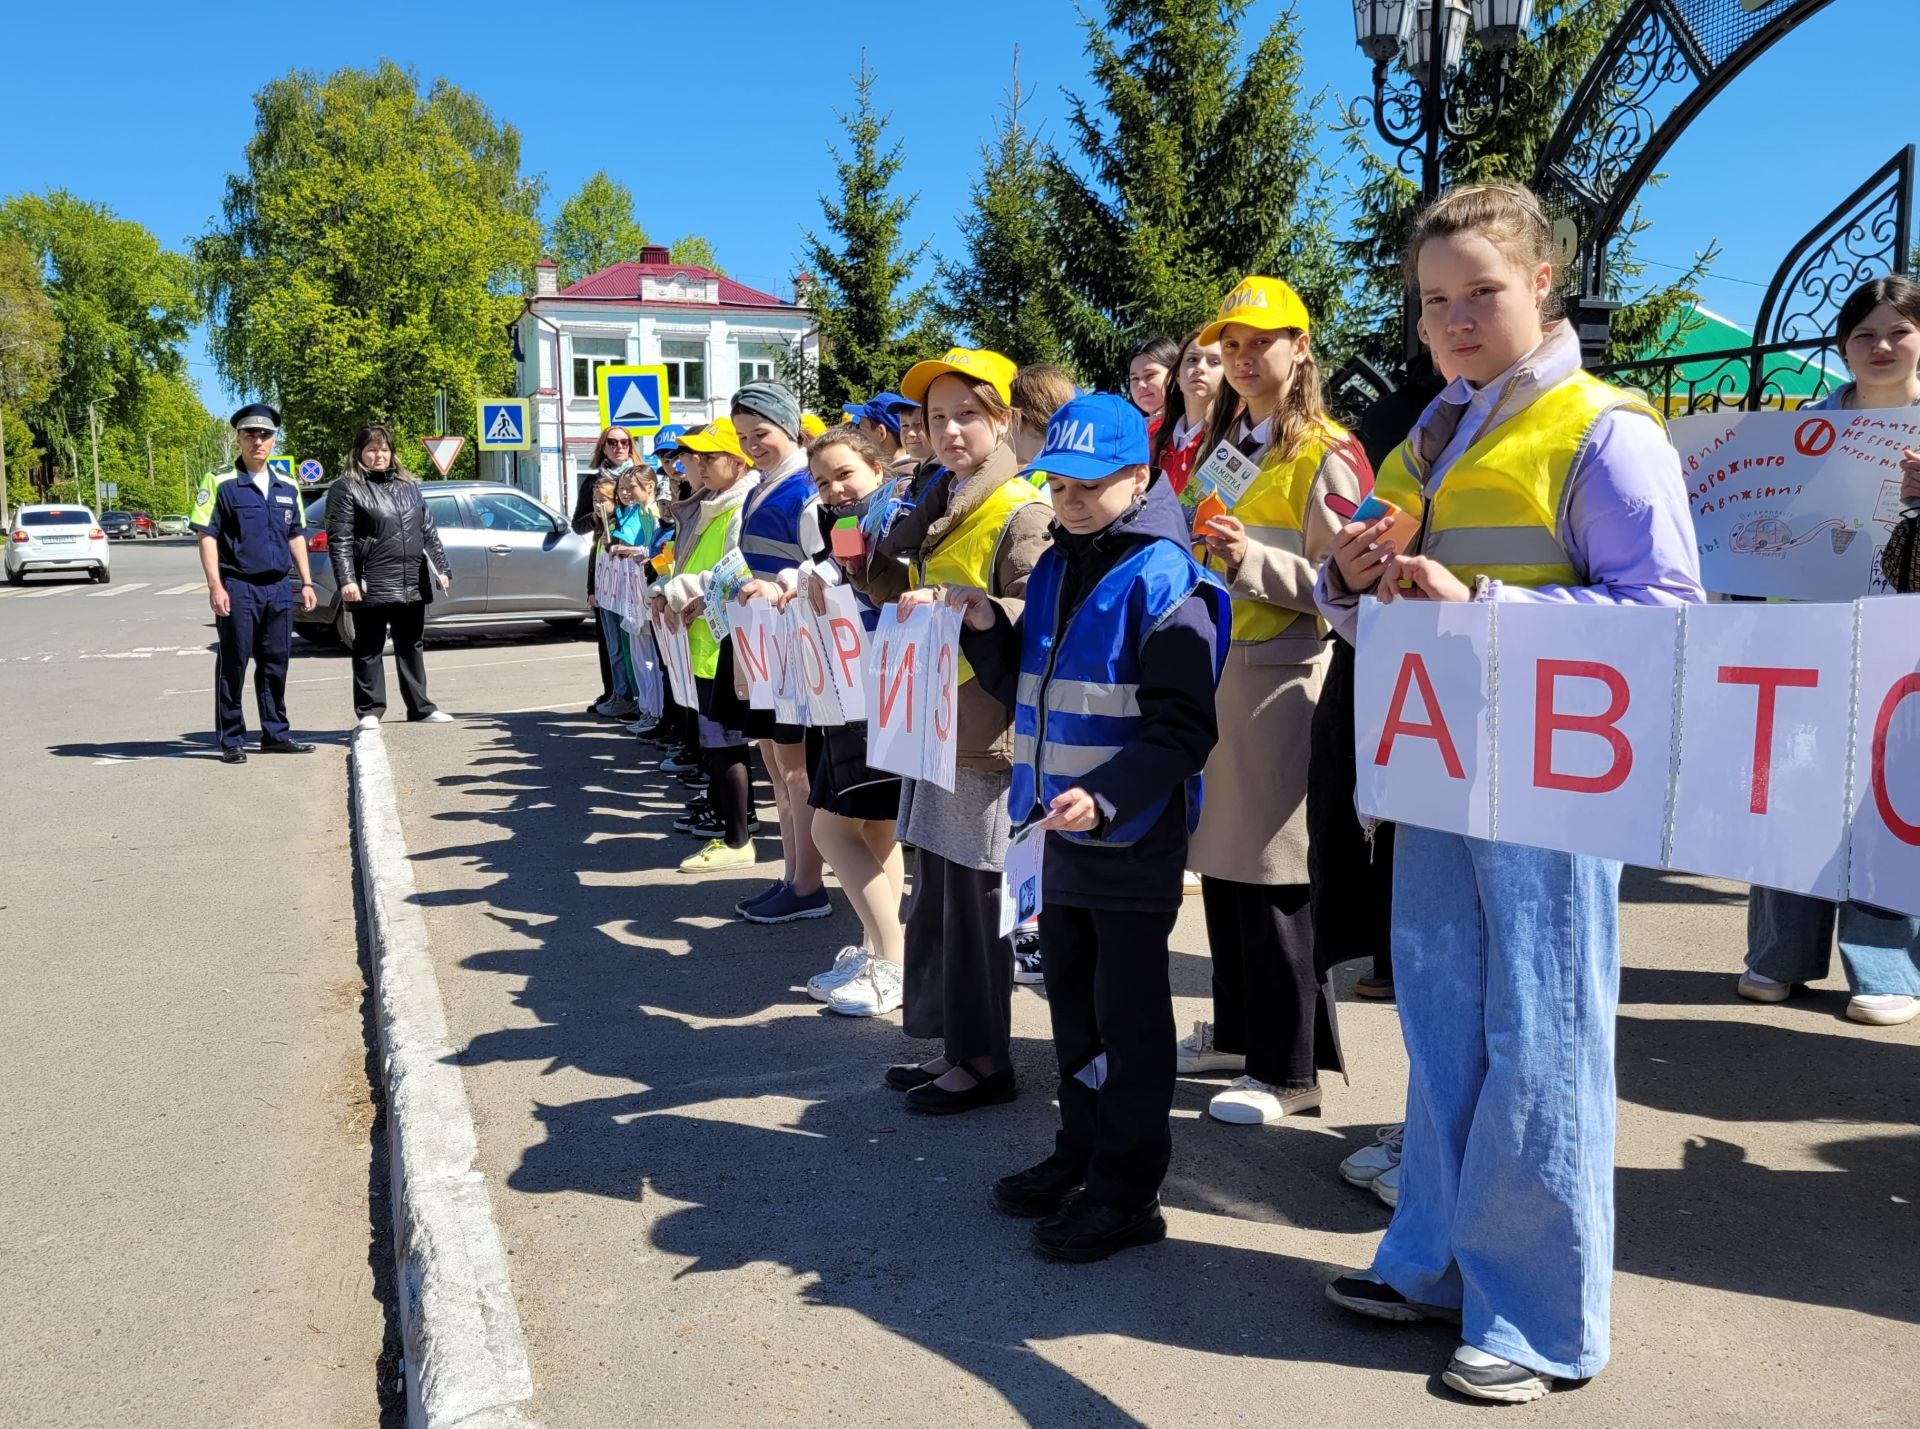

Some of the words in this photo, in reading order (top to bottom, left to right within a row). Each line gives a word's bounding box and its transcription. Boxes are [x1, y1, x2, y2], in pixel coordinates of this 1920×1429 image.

[1841, 428, 1864, 440] НЕ
[1851, 415, 1920, 435] ВОДИТЕ
[1209, 460, 1242, 491] ПАМЯТКА
[1700, 484, 1803, 516] ДВИЖЕНИЯ
[879, 640, 953, 743] ИЗ
